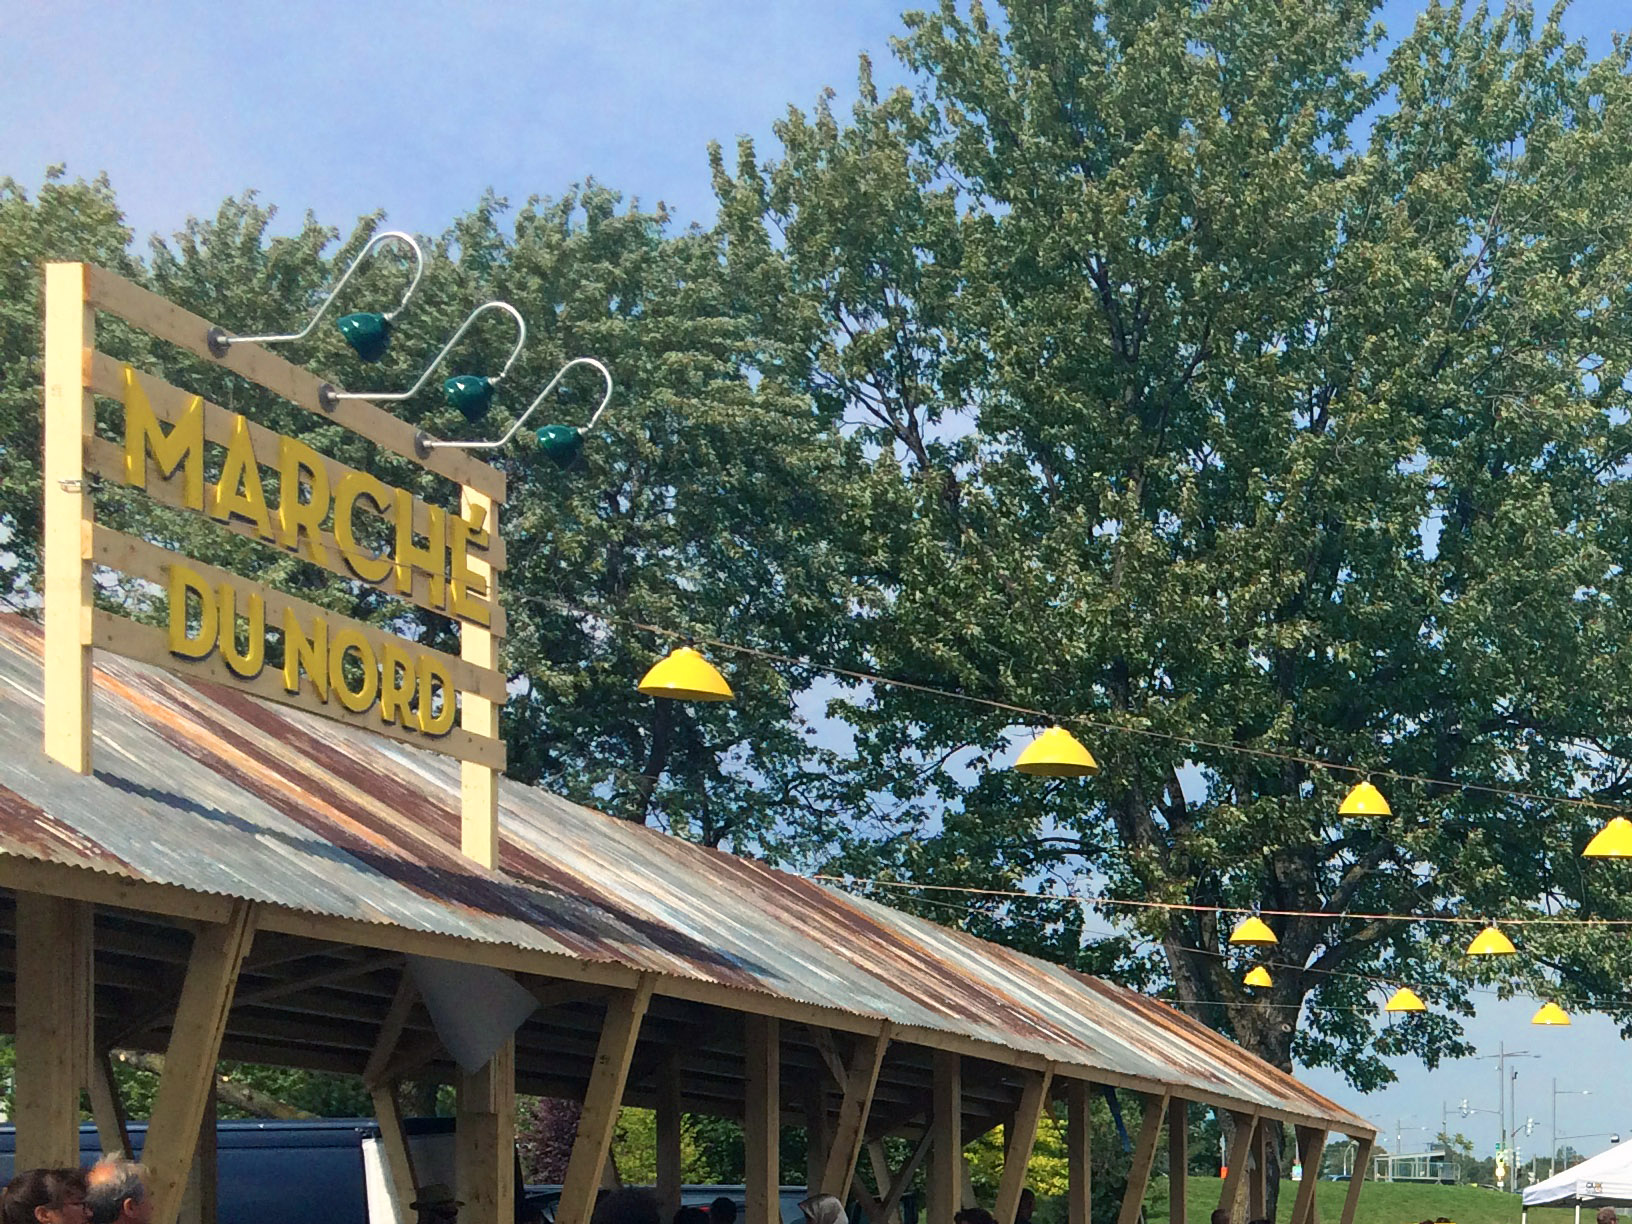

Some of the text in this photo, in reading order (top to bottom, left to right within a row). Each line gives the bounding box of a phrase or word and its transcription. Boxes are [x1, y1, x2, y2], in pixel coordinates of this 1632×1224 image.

[124, 363, 491, 627] MARCHÉ
[168, 565, 457, 738] DU NORD
